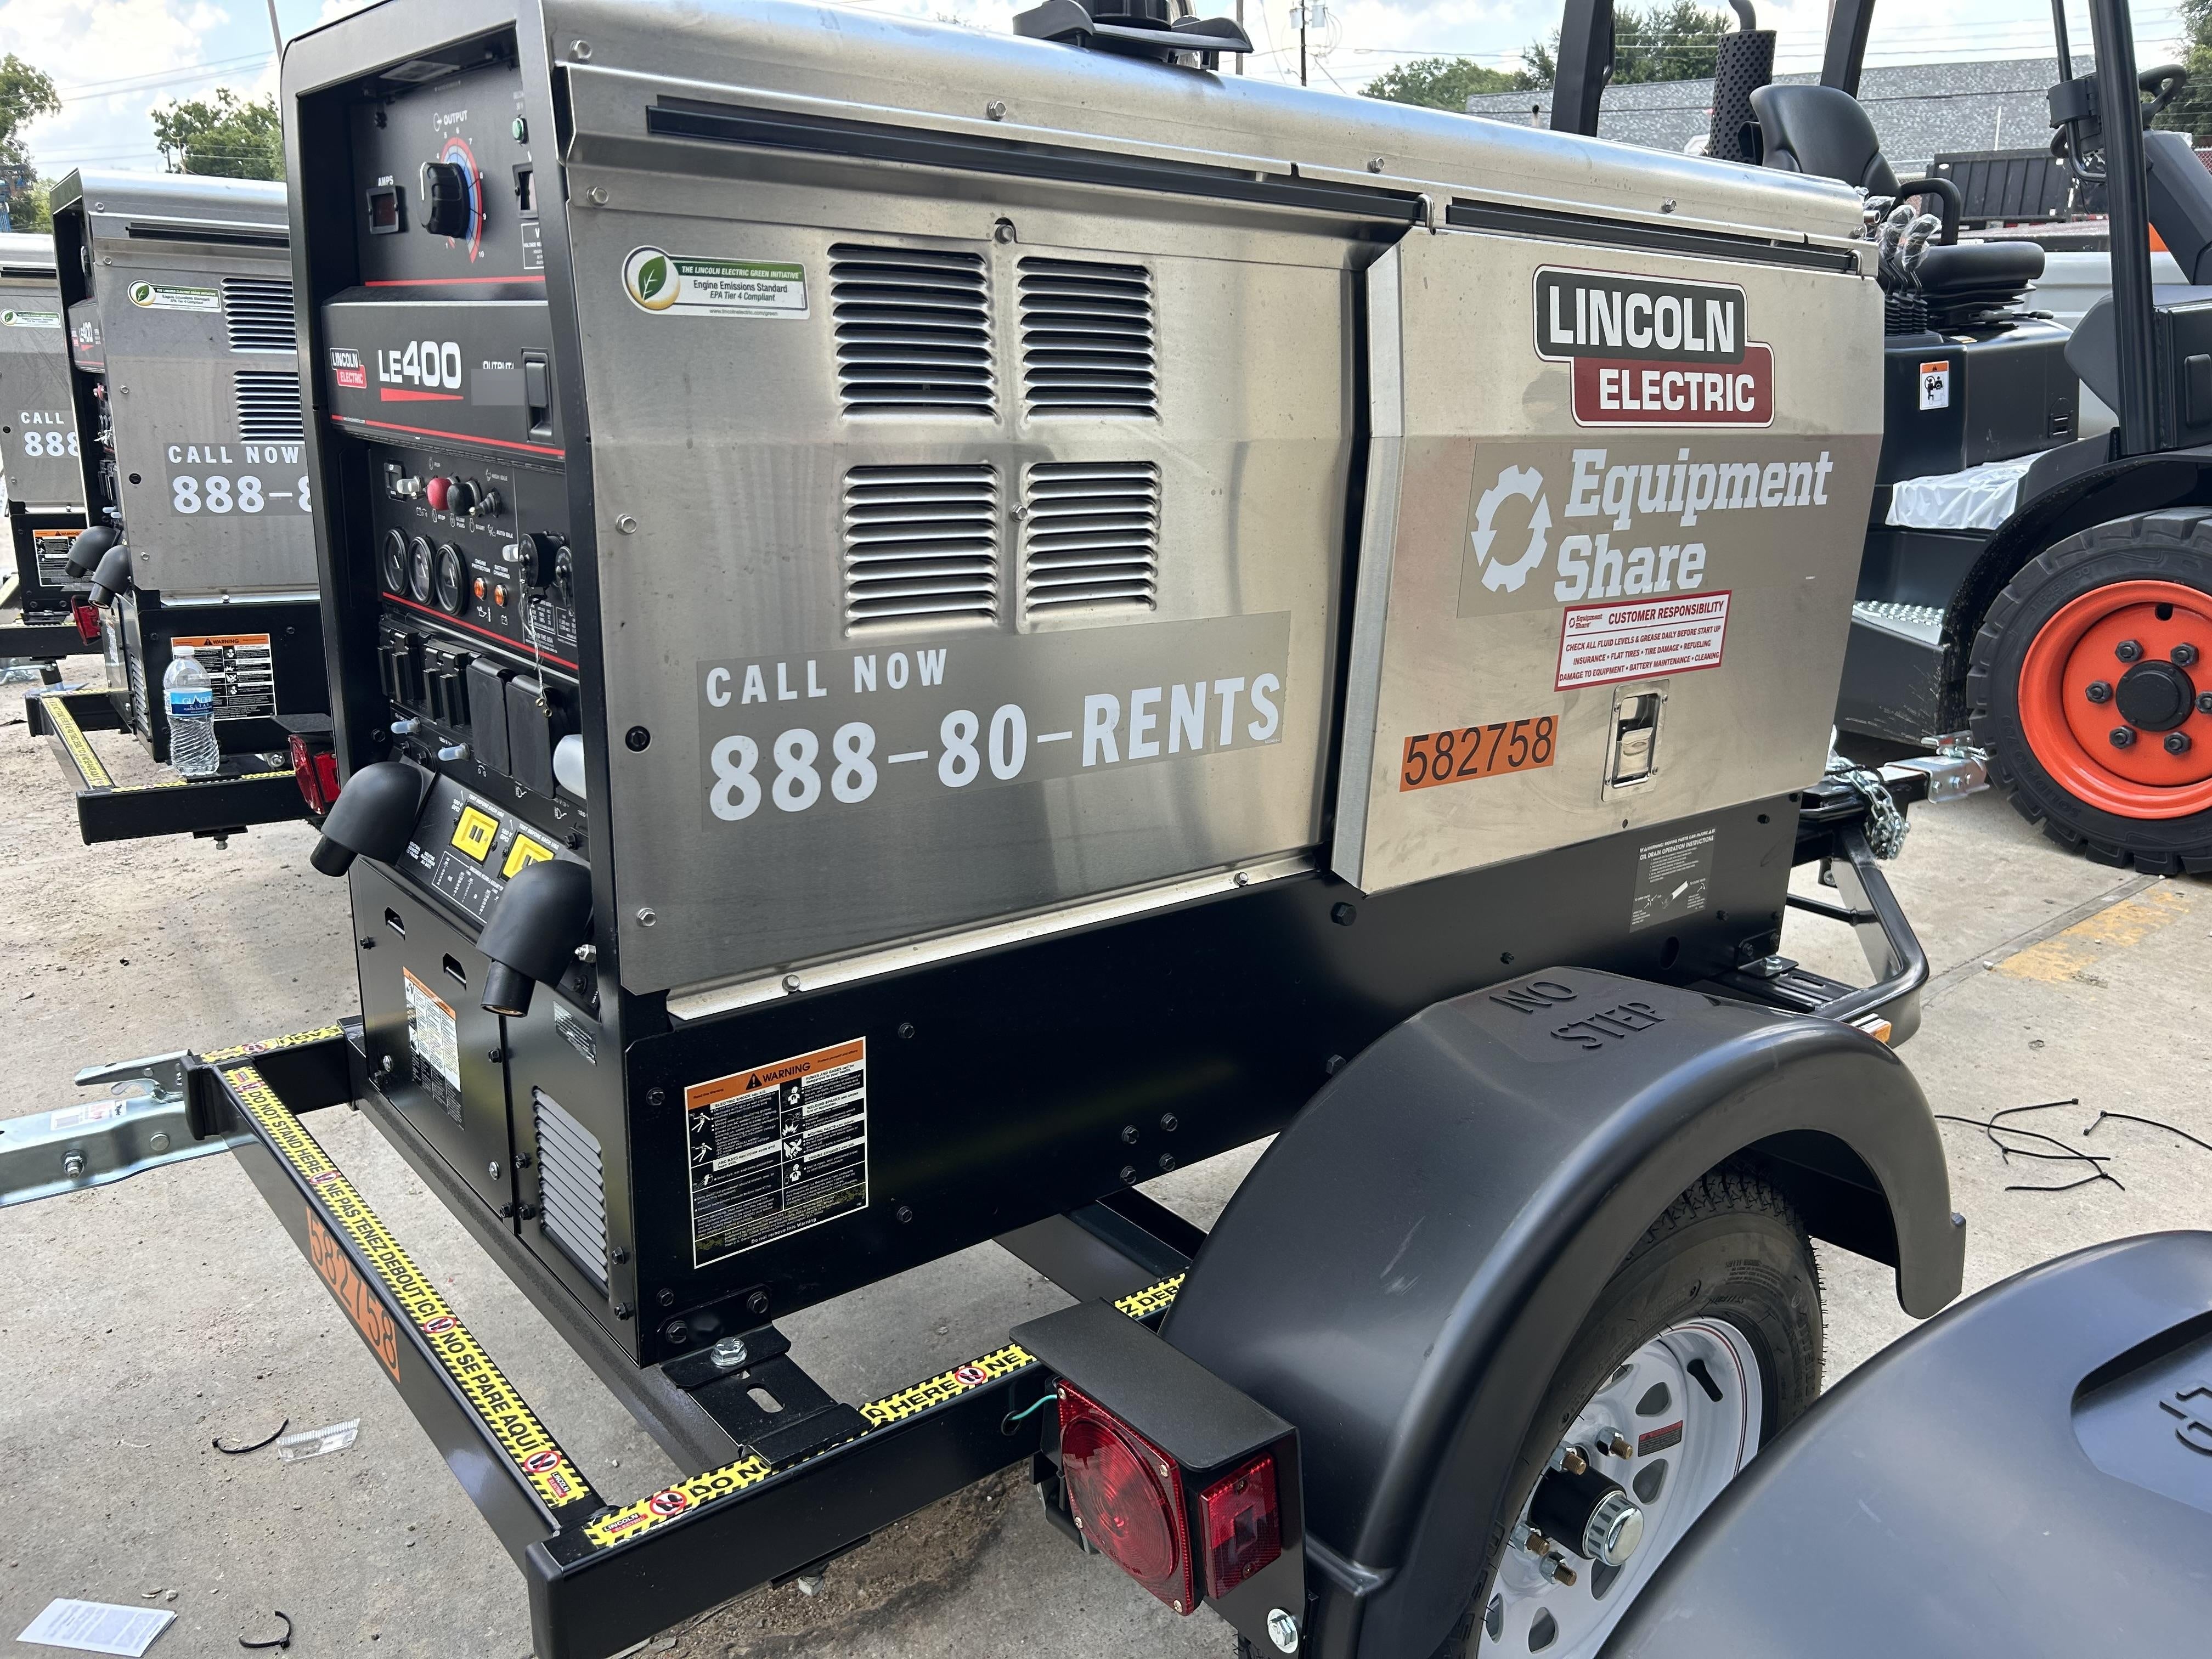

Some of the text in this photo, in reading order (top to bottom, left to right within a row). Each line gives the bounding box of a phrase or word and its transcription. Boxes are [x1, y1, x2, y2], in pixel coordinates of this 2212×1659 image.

[443, 110, 467, 124] OUTPUT
[377, 176, 394, 187] AMPS
[483, 212, 487, 221] 9
[682, 266, 693, 274] THE
[695, 266, 720, 275] LINCOLN
[721, 268, 748, 276] ELECTRIC
[693, 280, 787, 293] Engine Emissions Standard
[710, 291, 723, 300] EPA
[724, 291, 736, 300] Tier
[744, 292, 775, 302] Compliant
[1549, 285, 1734, 353] LINCOLN
[331, 352, 358, 369] LINCOLN
[377, 341, 462, 389] LE400
[340, 371, 364, 385] ELECTRIC
[1599, 369, 1755, 413] ELECTRIC
[20, 412, 65, 425] CALL
[168, 445, 299, 464] CALL NOW
[1564, 447, 1834, 531] Equipment
[1553, 534, 1706, 602] Share
[1576, 600, 1724, 625] Equipment CUSTOMER RESPONSIBILITY
[1566, 642, 1585, 652] CHECK
[1598, 639, 1613, 647] FLUID
[1615, 636, 1634, 646] LEVELS
[1640, 633, 1661, 642] GREASE
[1661, 631, 1677, 640] DAILY
[1677, 628, 1697, 637] BEFORE
[1697, 626, 1713, 635] START
[1573, 654, 1606, 665] INSURANCE
[1624, 649, 1640, 658] TIRES
[1645, 647, 1656, 656] TIRE
[1657, 645, 1679, 654] DAMAGE
[1684, 640, 1711, 650] REFUELING
[1559, 672, 1583, 681] DAMAGE
[1593, 665, 1624, 676] EQUIPMENT
[1629, 662, 1652, 672] BATTERY
[1653, 656, 1690, 668] MAINTENANCE
[1695, 652, 1719, 662] CLEANING
[705, 648, 948, 709] CALL NOW
[1404, 715, 1554, 786] 582758
[1662, 843, 1685, 854] OPERATION
[1686, 835, 1714, 848] INSTRUCTIONS
[1489, 981, 1579, 1014] NO
[1550, 1001, 1666, 1049] STEP
[763, 1061, 810, 1083] WARNING
[806, 1075, 825, 1084] dangerous
[715, 1098, 735, 1107] ELECTRIC
[807, 1102, 824, 1110] WELDING
[248, 1091, 325, 1173] DO NOT STAND HERE
[808, 1128, 822, 1137] MOVING
[823, 1147, 840, 1155] EXHAUST
[768, 1227, 786, 1238] remove
[797, 1217, 816, 1228] Warning
[323, 1183, 439, 1317] NE PAS TENEZ DEBOUT ICI
[310, 1209, 396, 1370] 582758
[439, 1331, 466, 1353] NO
[456, 1354, 483, 1374] SE
[470, 1373, 512, 1414] PARE
[986, 1352, 1022, 1373] NE
[890, 1380, 959, 1414] HERE
[549, 1477, 565, 1498] ELECTRIC
[552, 1472, 571, 1493] LINCOLN
[688, 1476, 733, 1498] DO
[603, 1513, 639, 1532] LINCOLN
[615, 1515, 646, 1532] ELECTRIC
